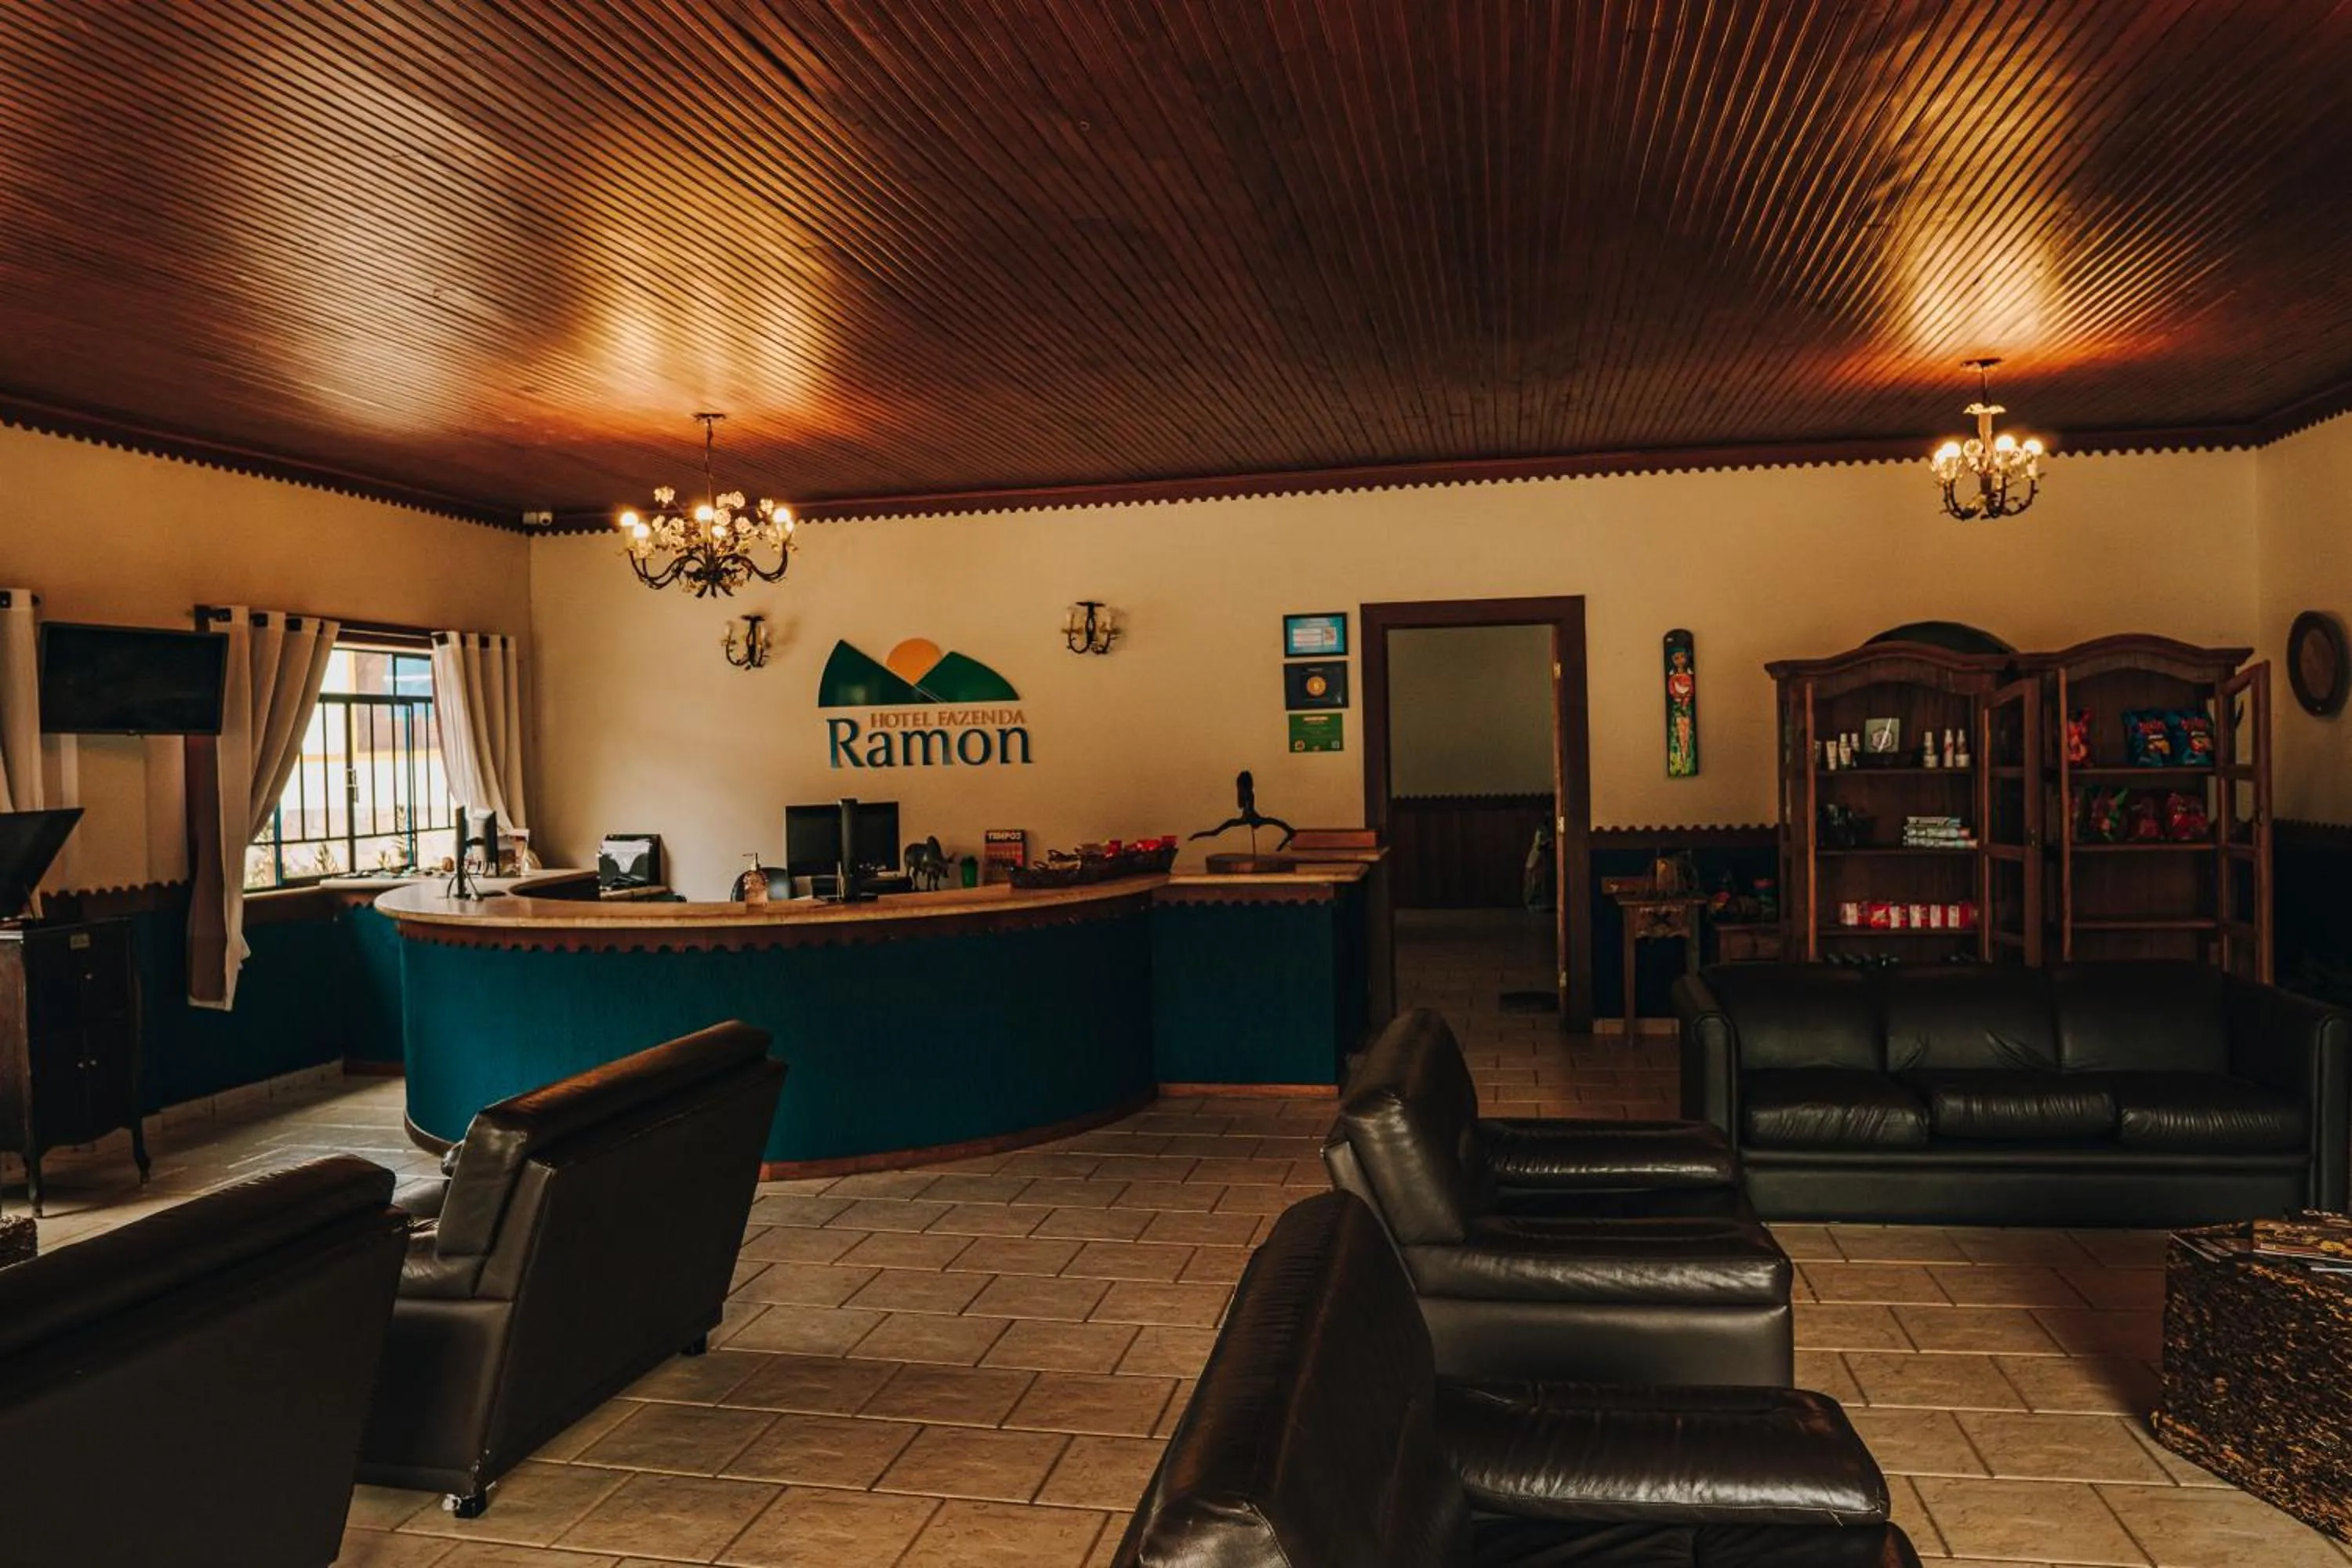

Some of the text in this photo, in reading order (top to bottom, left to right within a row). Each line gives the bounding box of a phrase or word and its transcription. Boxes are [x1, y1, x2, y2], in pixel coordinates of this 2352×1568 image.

[870, 709, 1027, 728] HOTEL FAZENDA
[826, 717, 1033, 768] Ramon
